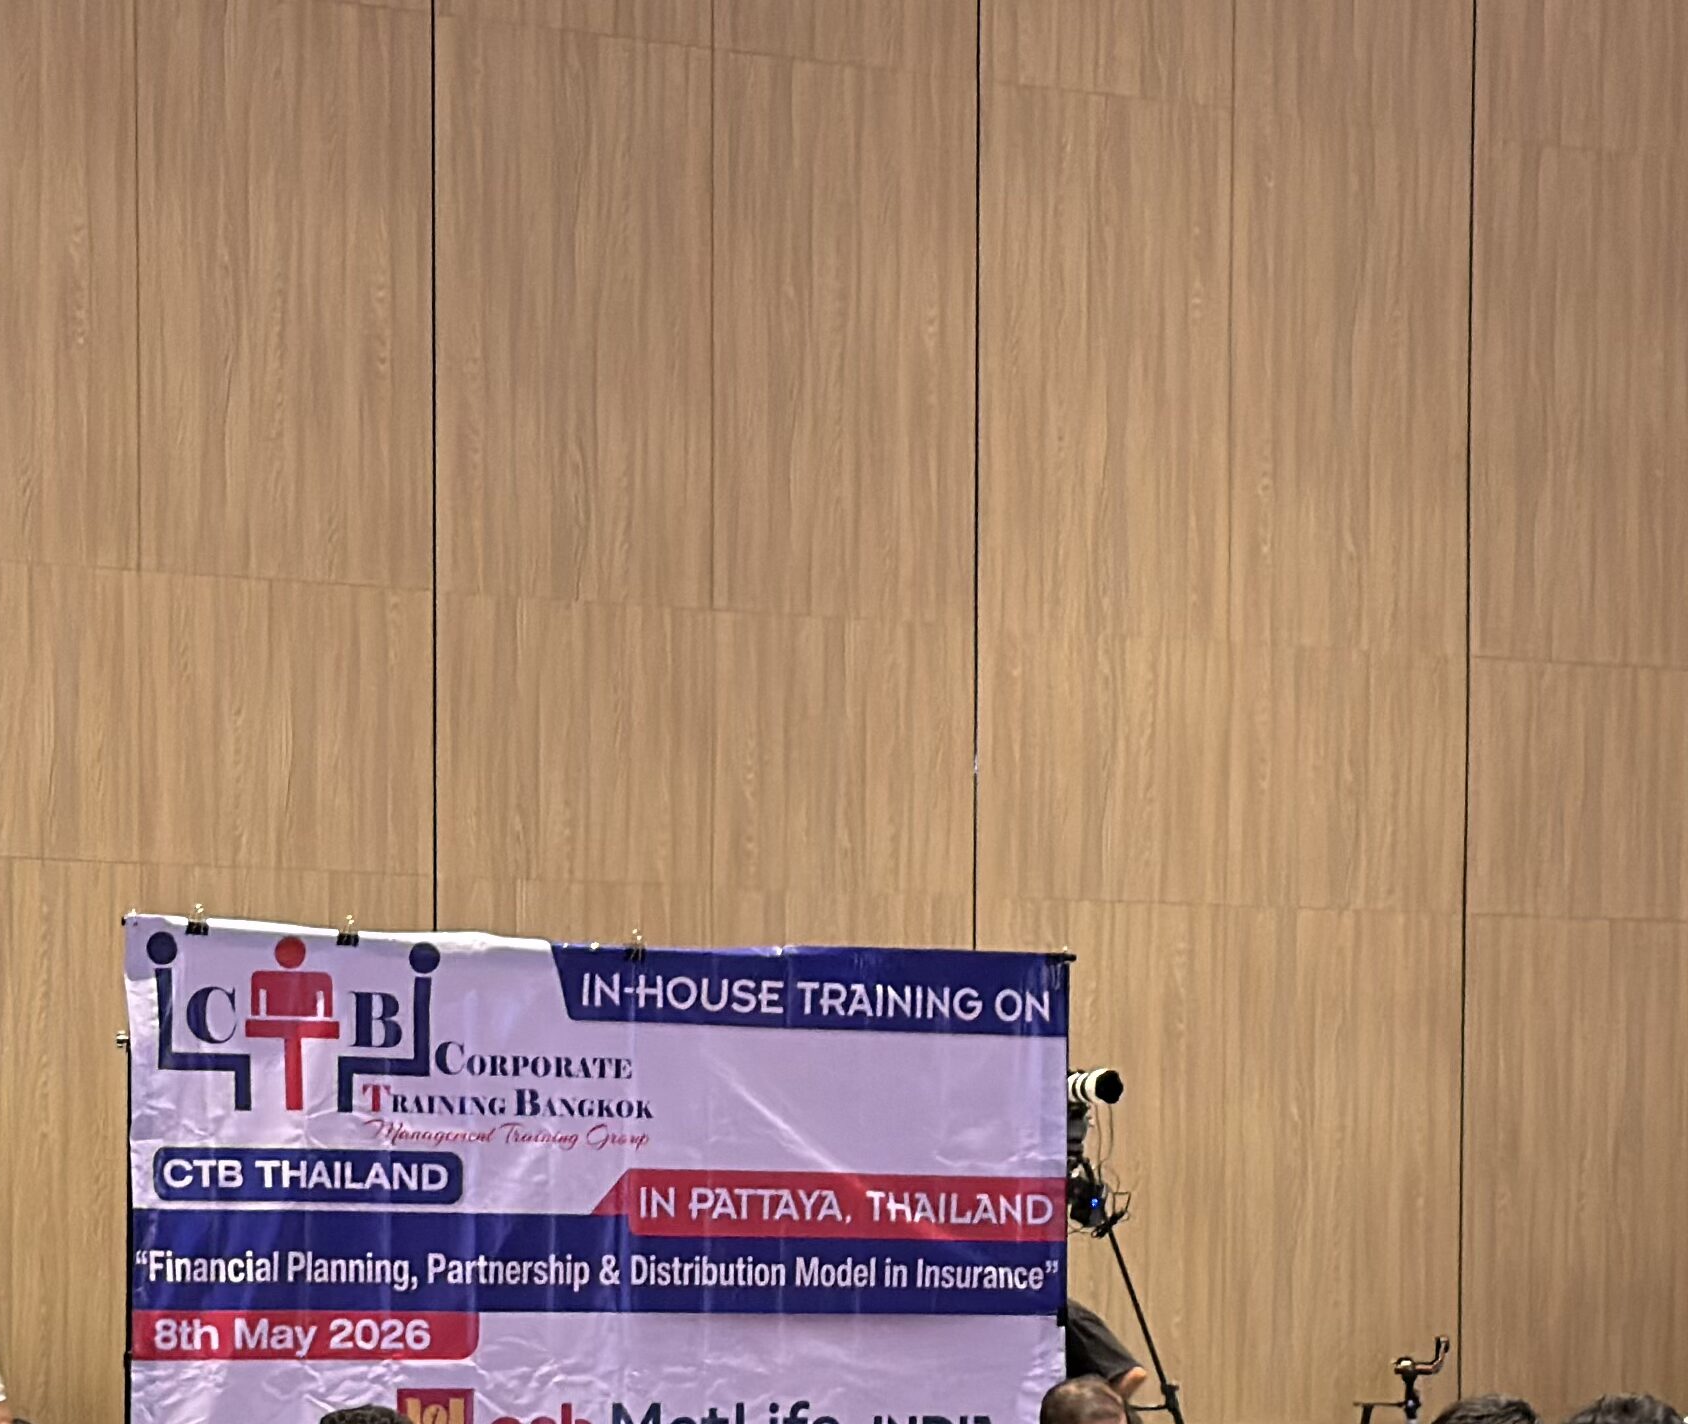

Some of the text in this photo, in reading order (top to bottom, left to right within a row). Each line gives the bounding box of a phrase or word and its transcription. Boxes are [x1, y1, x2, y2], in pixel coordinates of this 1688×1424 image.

[582, 972, 1051, 1023] IN-HOUSE TRAINING ON
[435, 1041, 632, 1080] CORPORATE
[362, 1083, 654, 1119] TRAINING BANGKOK
[364, 1119, 650, 1150] Management Training Group
[162, 1158, 449, 1192] CTB THAILAND
[639, 1186, 1054, 1226] IN PATTAYA, THAILAND
[287, 1252, 418, 1292] Planning,
[427, 1253, 591, 1293] Partnership
[599, 1254, 620, 1286] &
[630, 1254, 786, 1288] Distribution
[796, 1256, 876, 1289] Model
[885, 1257, 908, 1289] in
[154, 1318, 431, 1358] 8th May 2026
